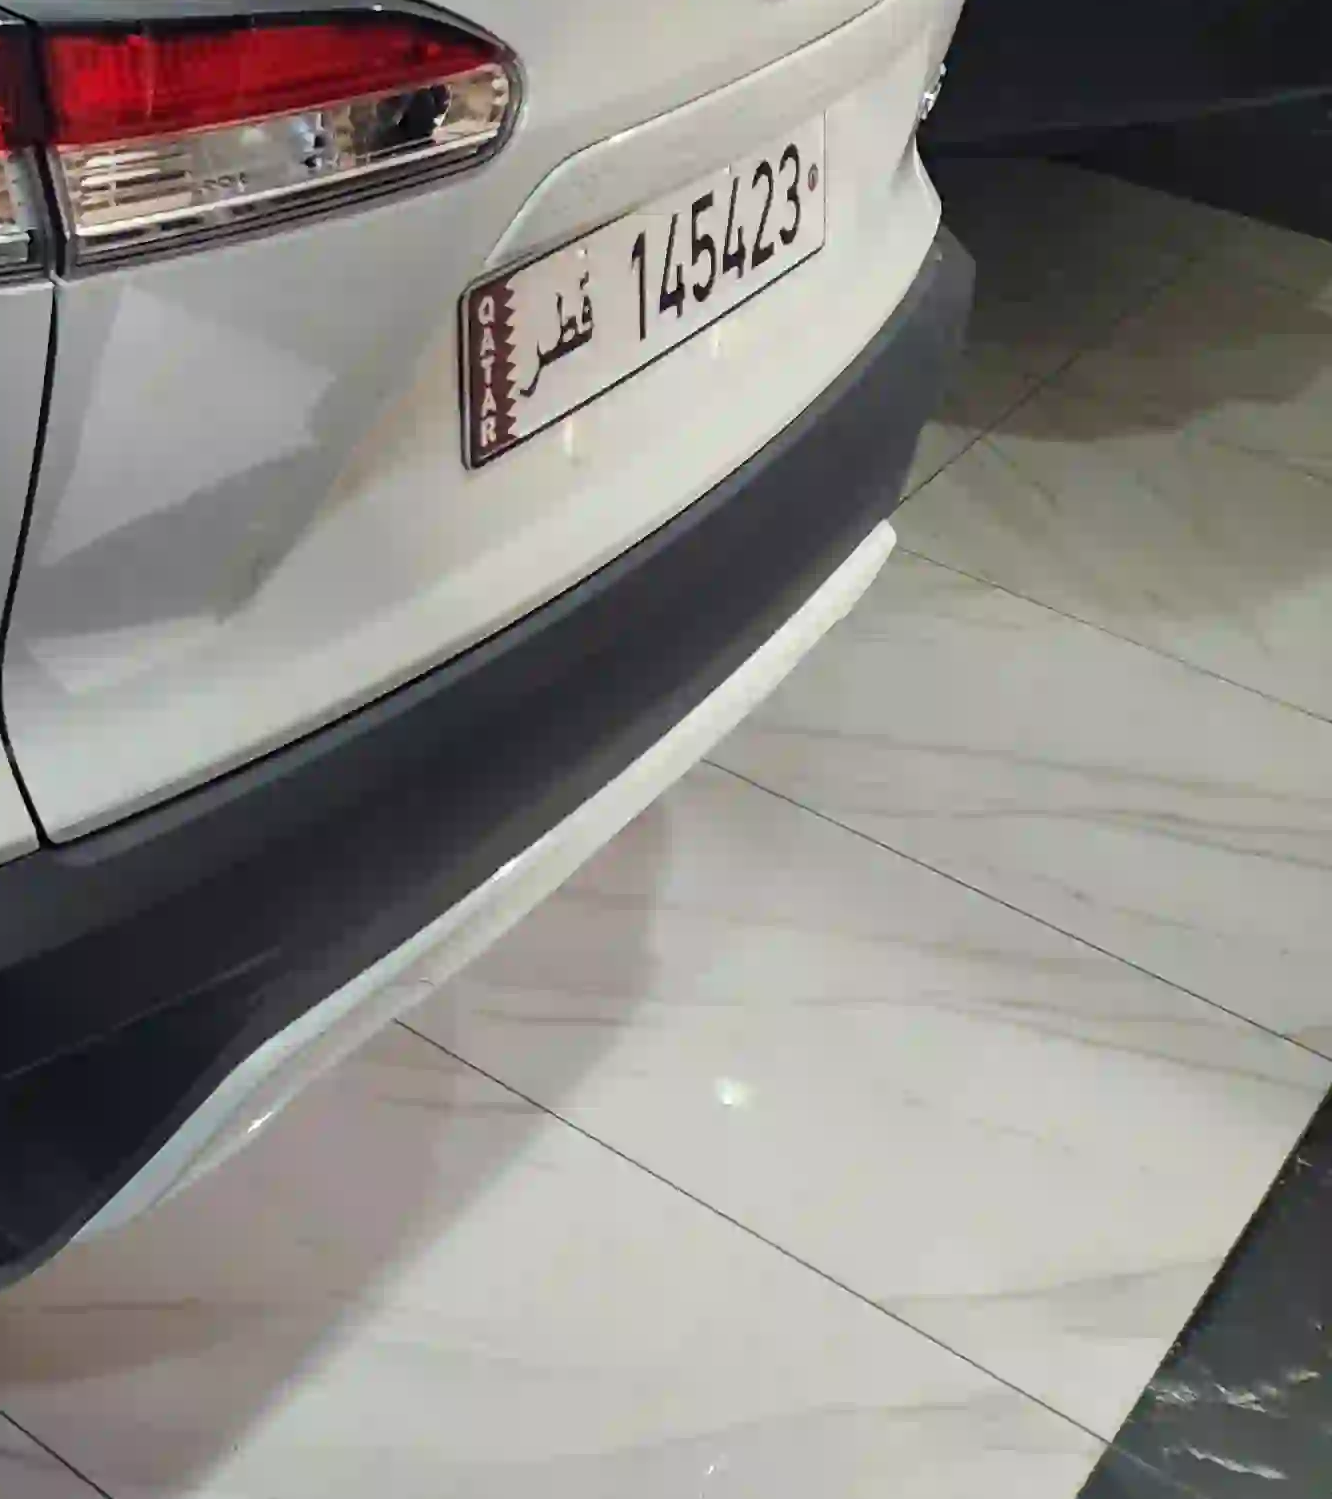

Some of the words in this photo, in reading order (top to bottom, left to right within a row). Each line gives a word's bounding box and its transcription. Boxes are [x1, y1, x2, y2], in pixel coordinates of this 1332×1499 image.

[631, 143, 801, 341] 145423
[477, 294, 498, 448] QATAR
[519, 270, 595, 398] قطر
